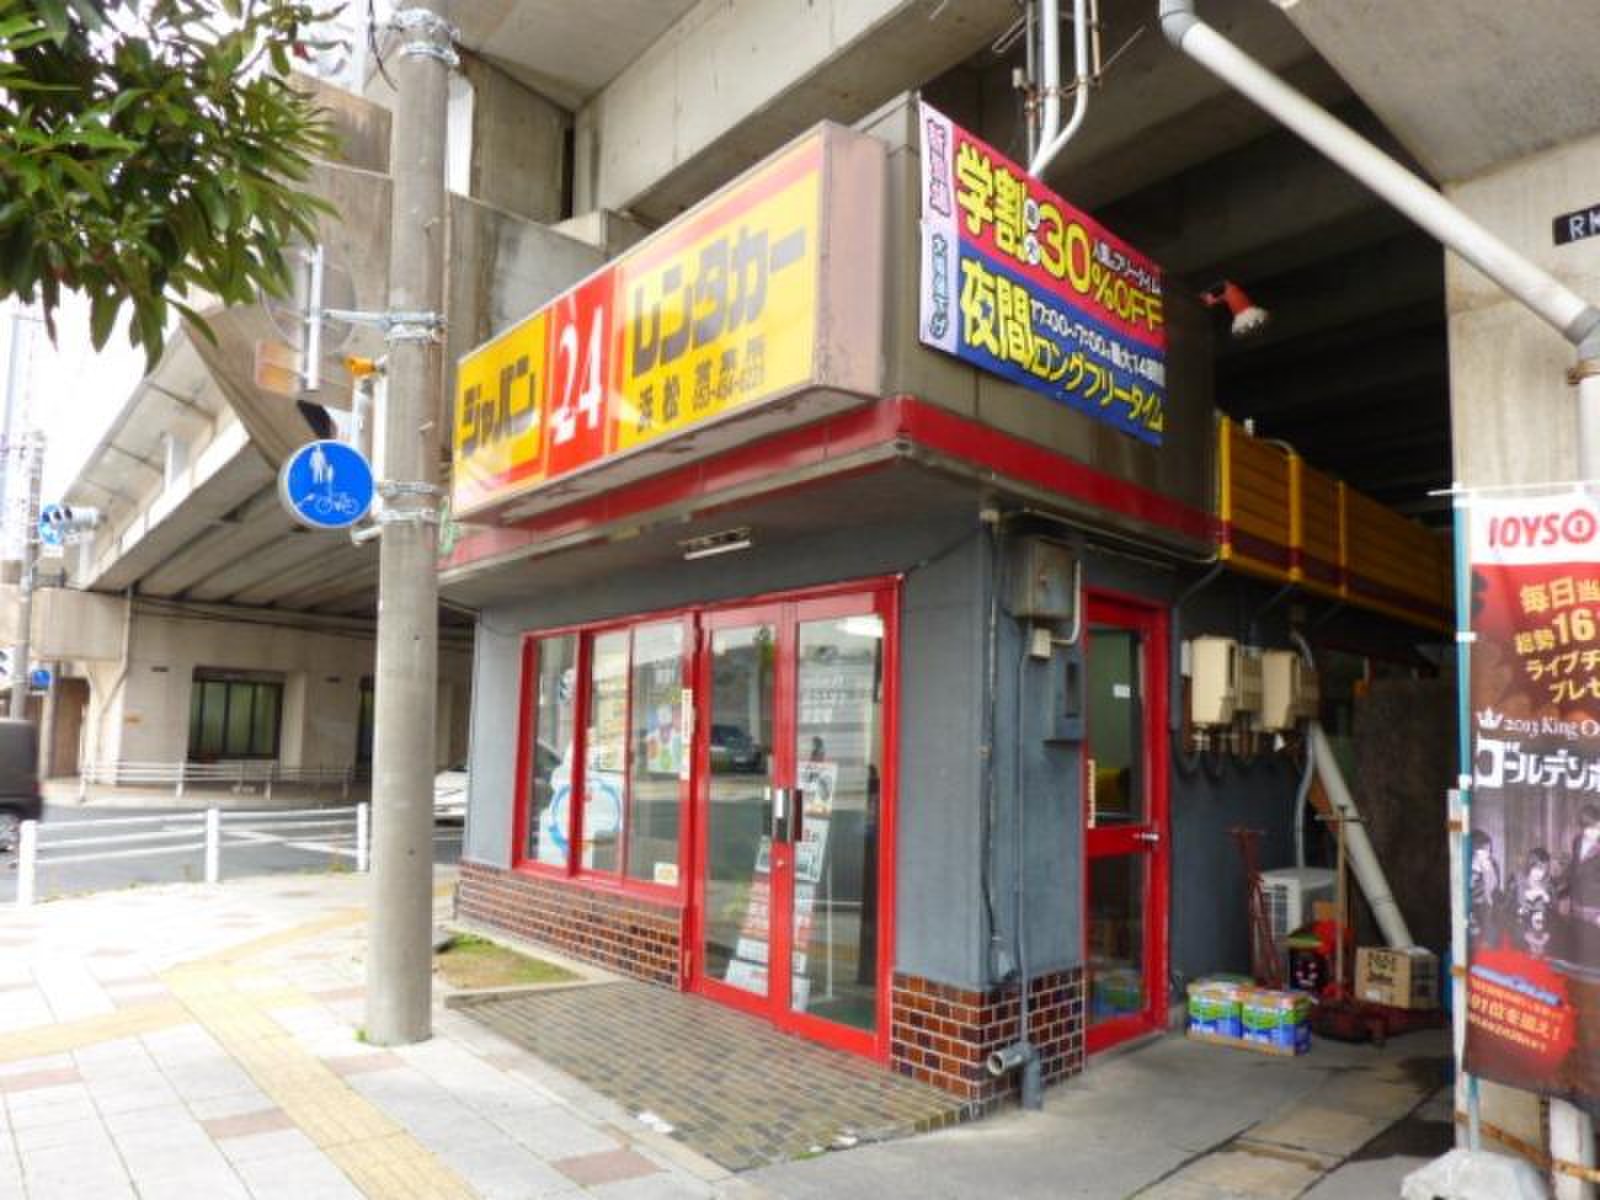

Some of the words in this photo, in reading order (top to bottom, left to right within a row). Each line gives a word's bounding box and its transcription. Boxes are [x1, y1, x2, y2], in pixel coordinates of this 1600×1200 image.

[957, 140, 1026, 262] 学割
[549, 306, 604, 446] 24
[631, 226, 806, 379] レンタカー
[960, 257, 1032, 369] 夜間
[1541, 715, 1579, 740] King
